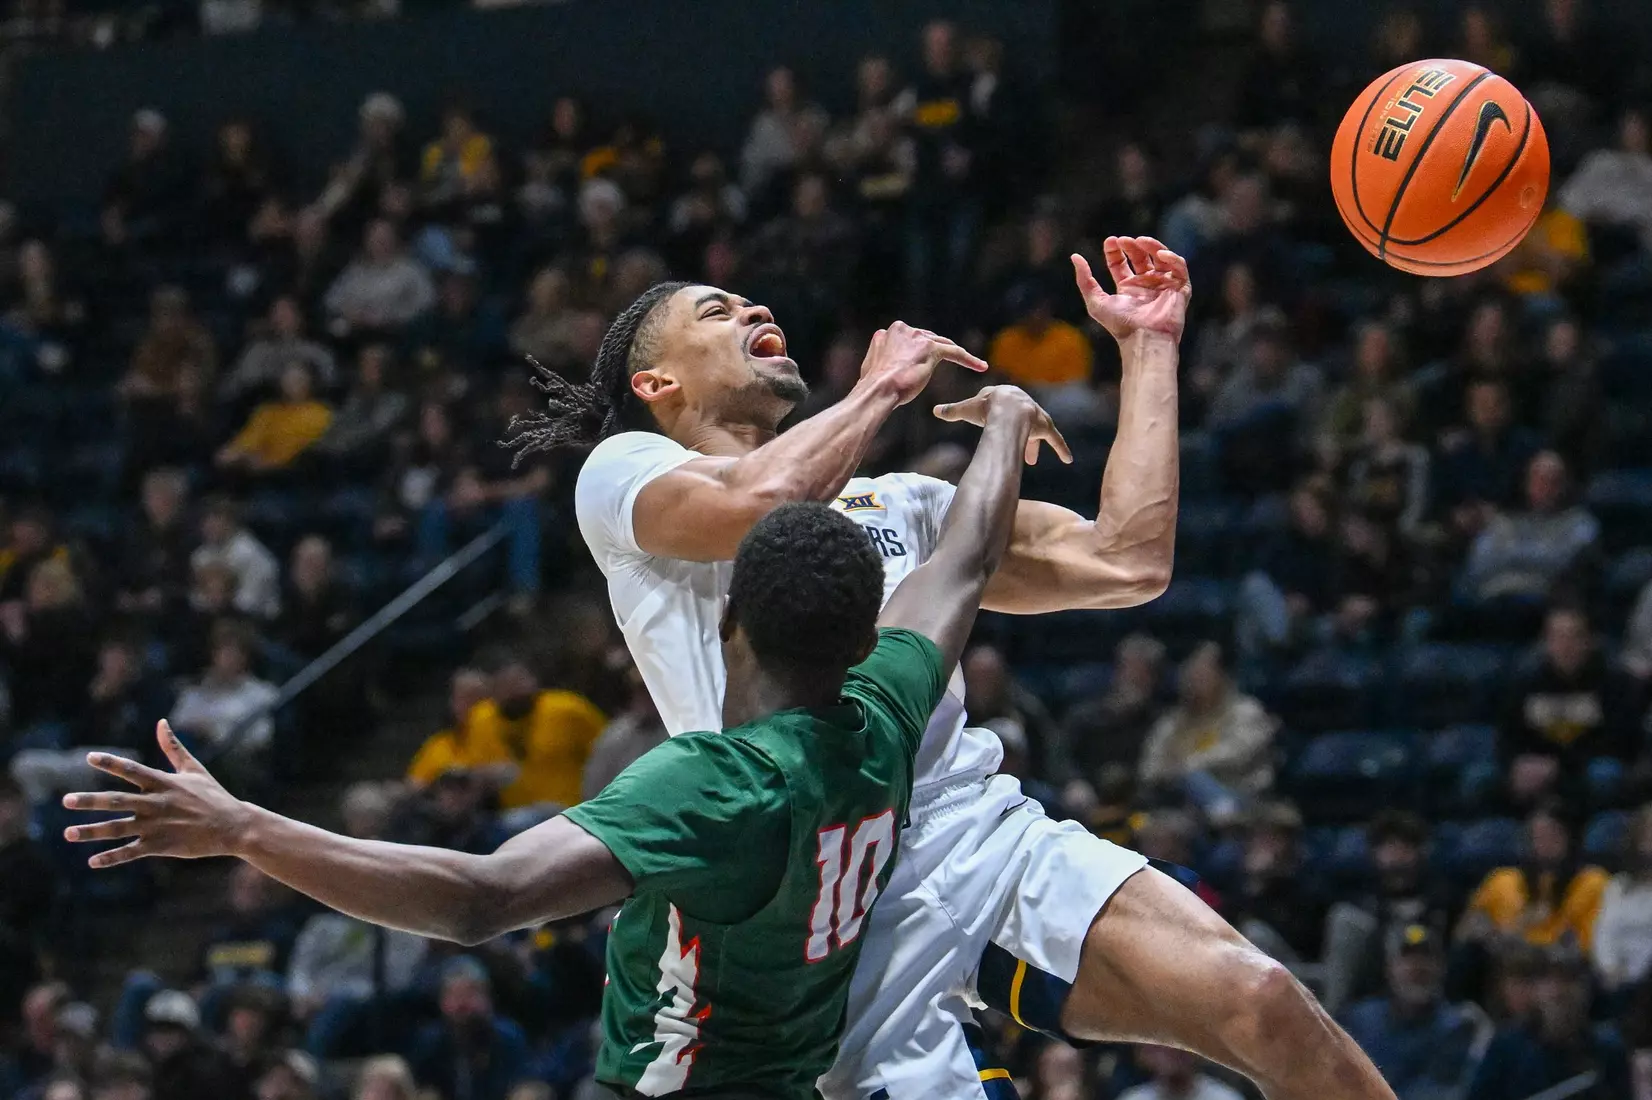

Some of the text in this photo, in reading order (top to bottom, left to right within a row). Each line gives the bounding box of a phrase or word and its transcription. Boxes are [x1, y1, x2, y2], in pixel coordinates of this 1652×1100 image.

[1374, 70, 1457, 162] ELITE
[838, 493, 882, 511] XII
[861, 525, 907, 557] RS
[804, 808, 895, 964] 10
